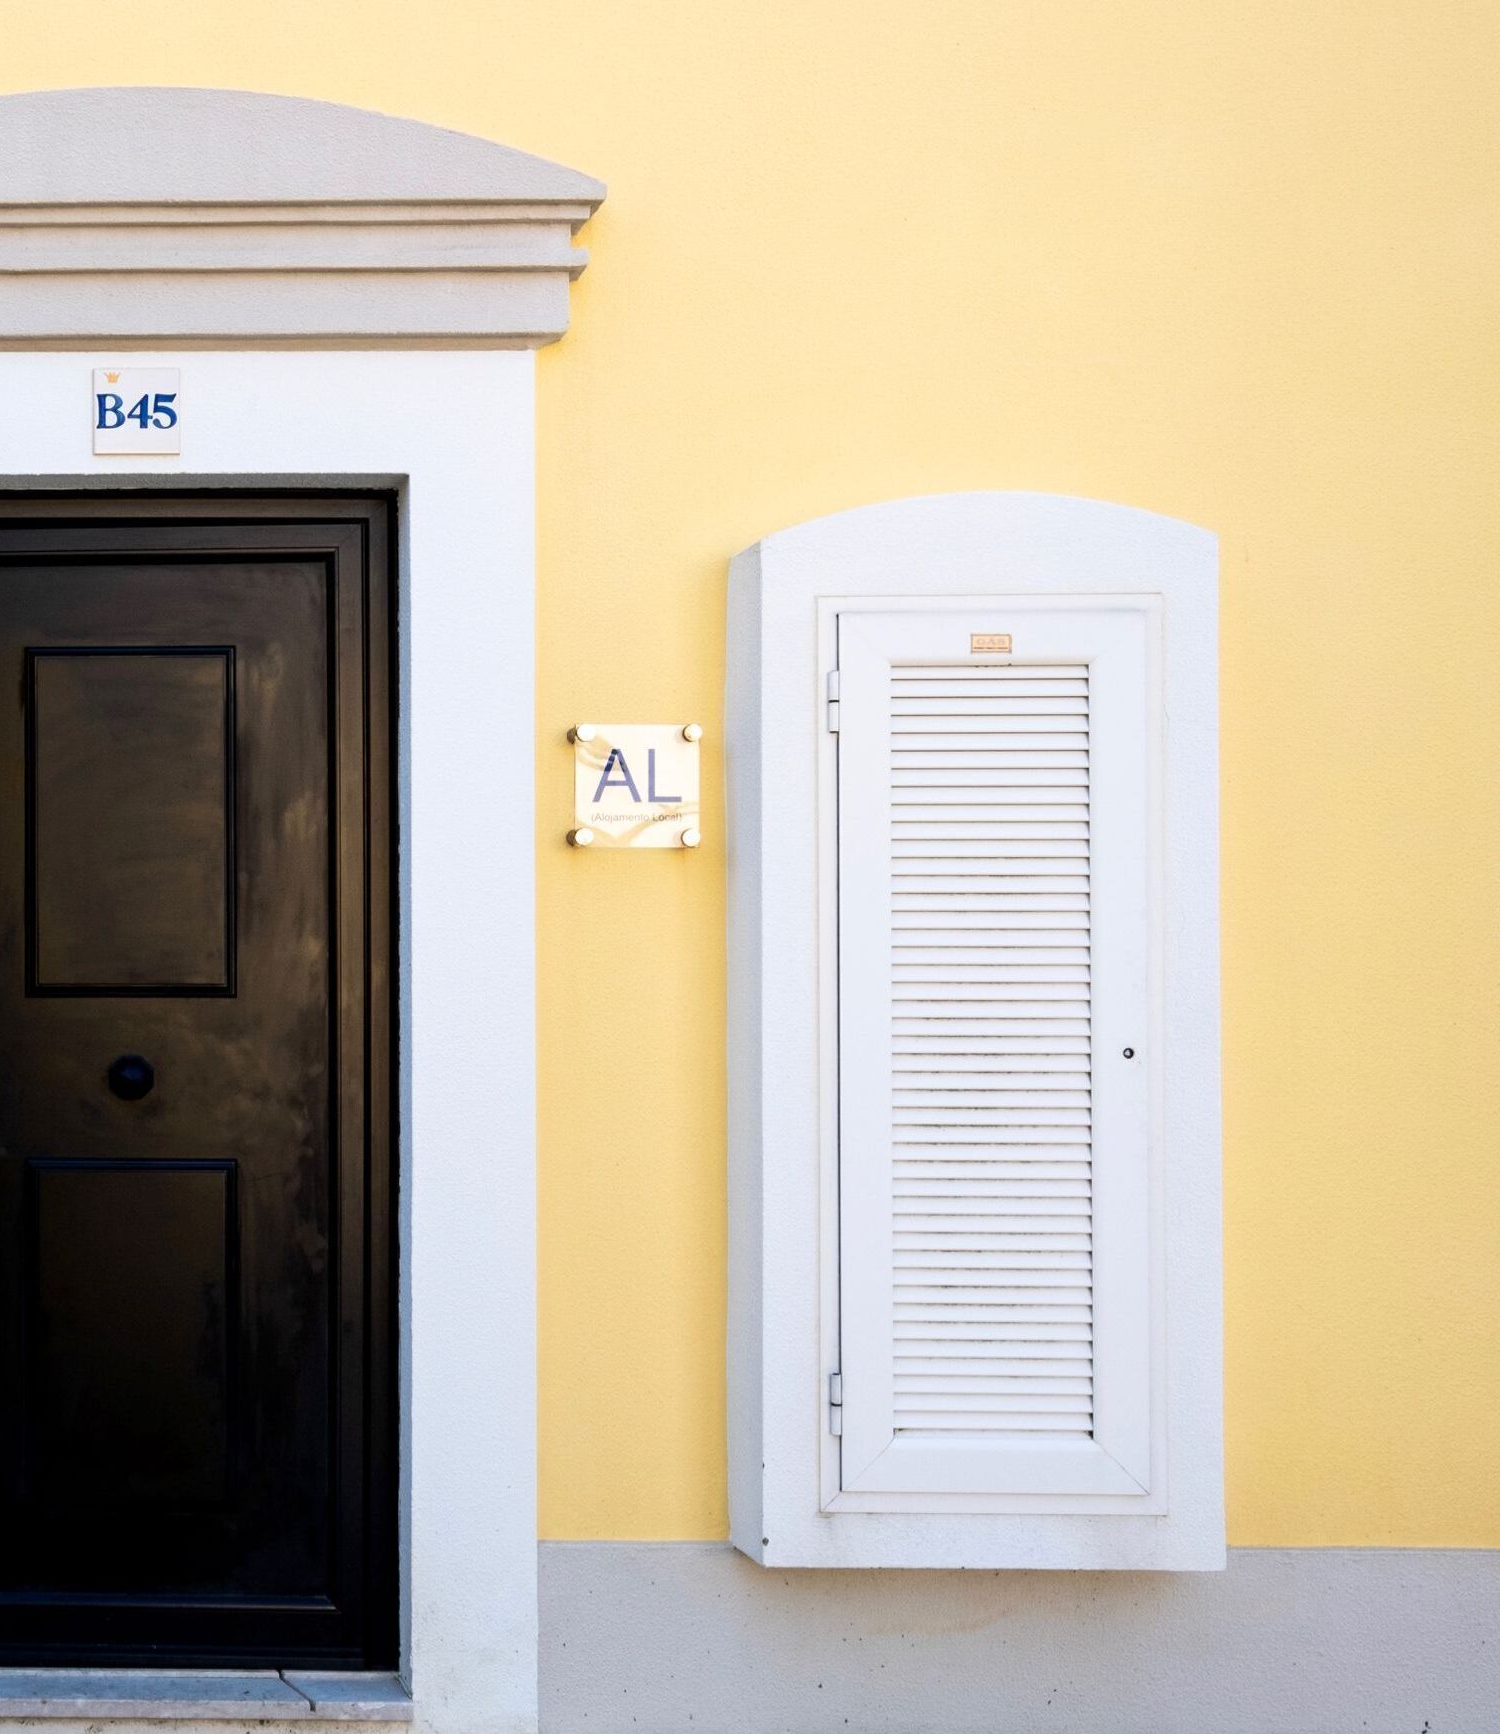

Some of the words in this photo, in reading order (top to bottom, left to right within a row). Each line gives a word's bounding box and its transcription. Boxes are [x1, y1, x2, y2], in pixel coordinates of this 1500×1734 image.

[96, 393, 178, 429] B45
[592, 748, 682, 803] AL
[591, 812, 650, 824] (Alojamento
